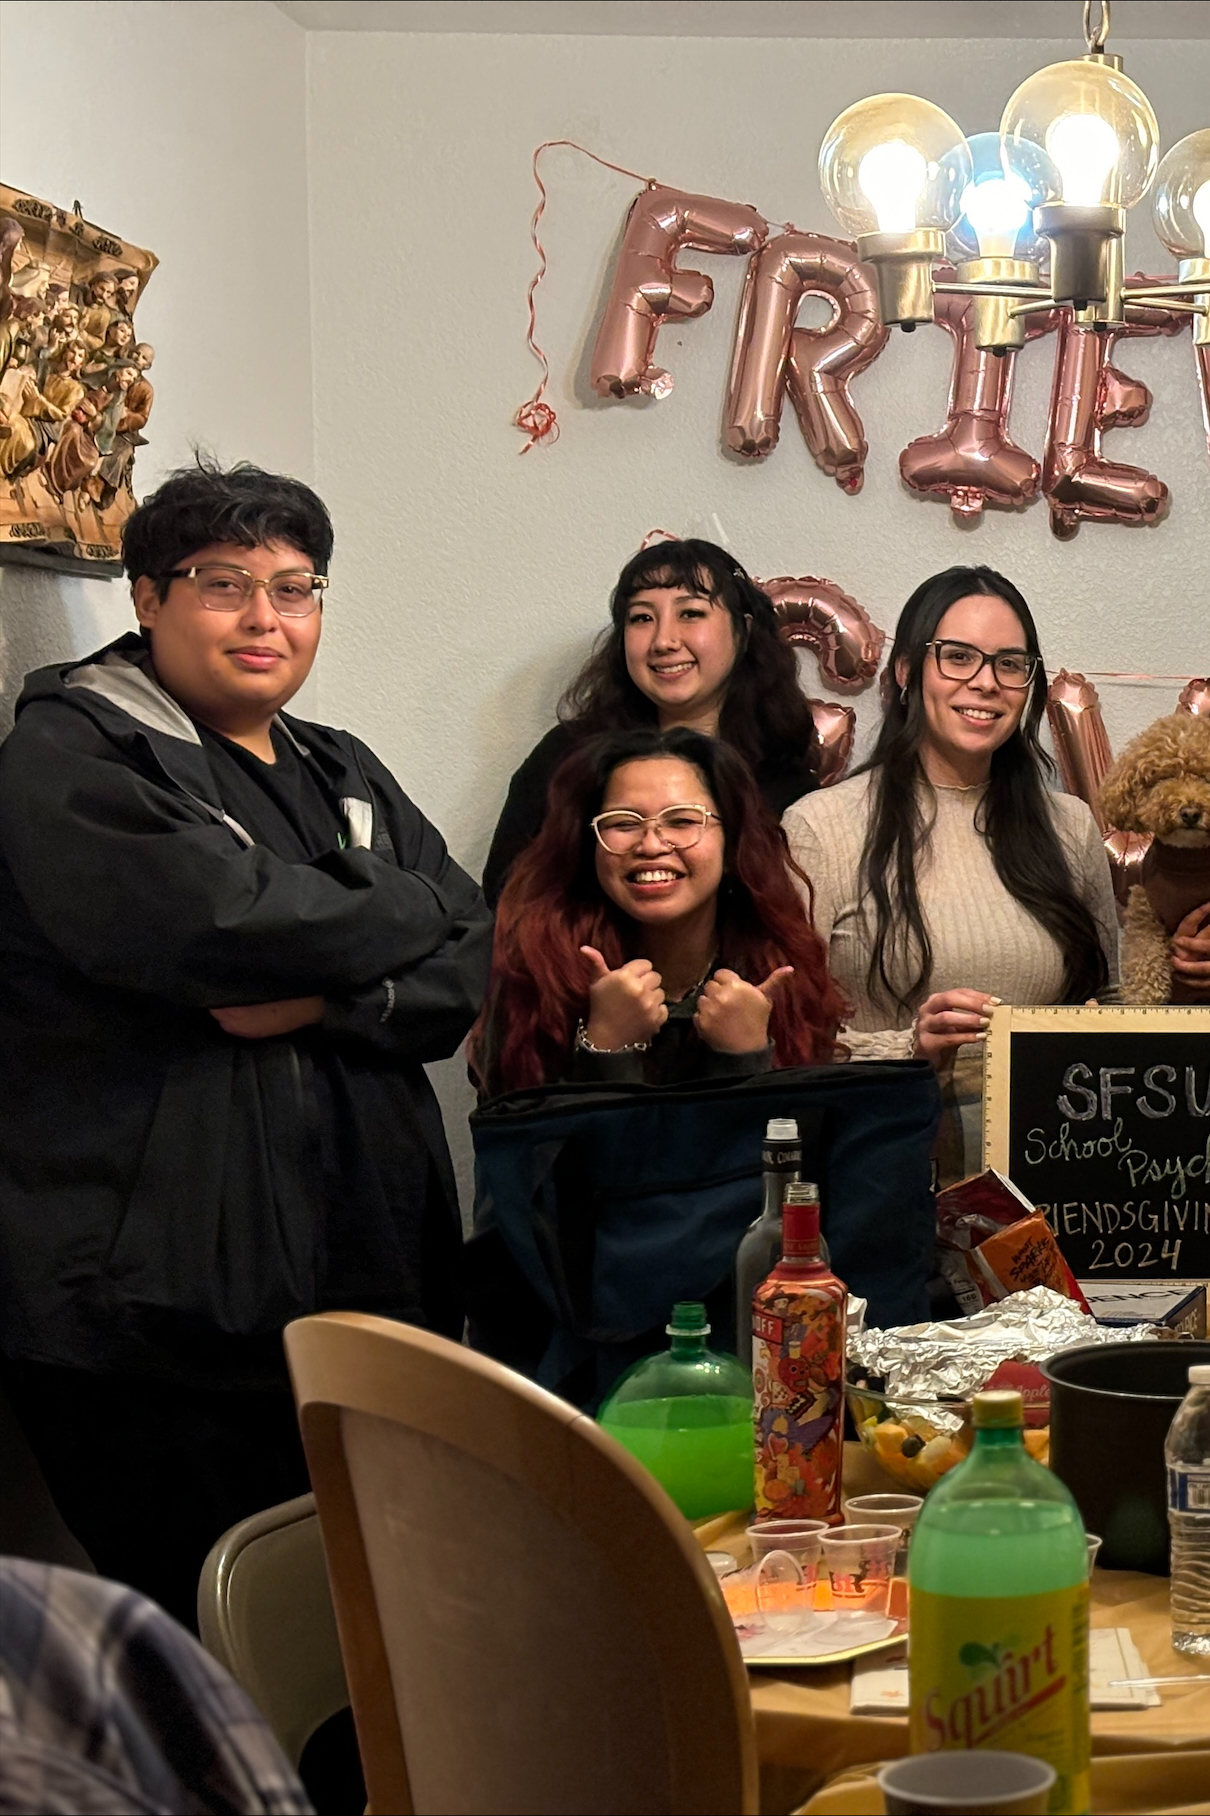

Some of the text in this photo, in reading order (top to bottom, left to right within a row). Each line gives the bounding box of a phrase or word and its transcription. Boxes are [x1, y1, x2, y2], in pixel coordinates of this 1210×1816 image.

[1025, 1117, 1132, 1166] School
[1088, 1238, 1182, 1271] 2024
[752, 1314, 775, 1336] OFF
[922, 1624, 1058, 1752] Squirt
